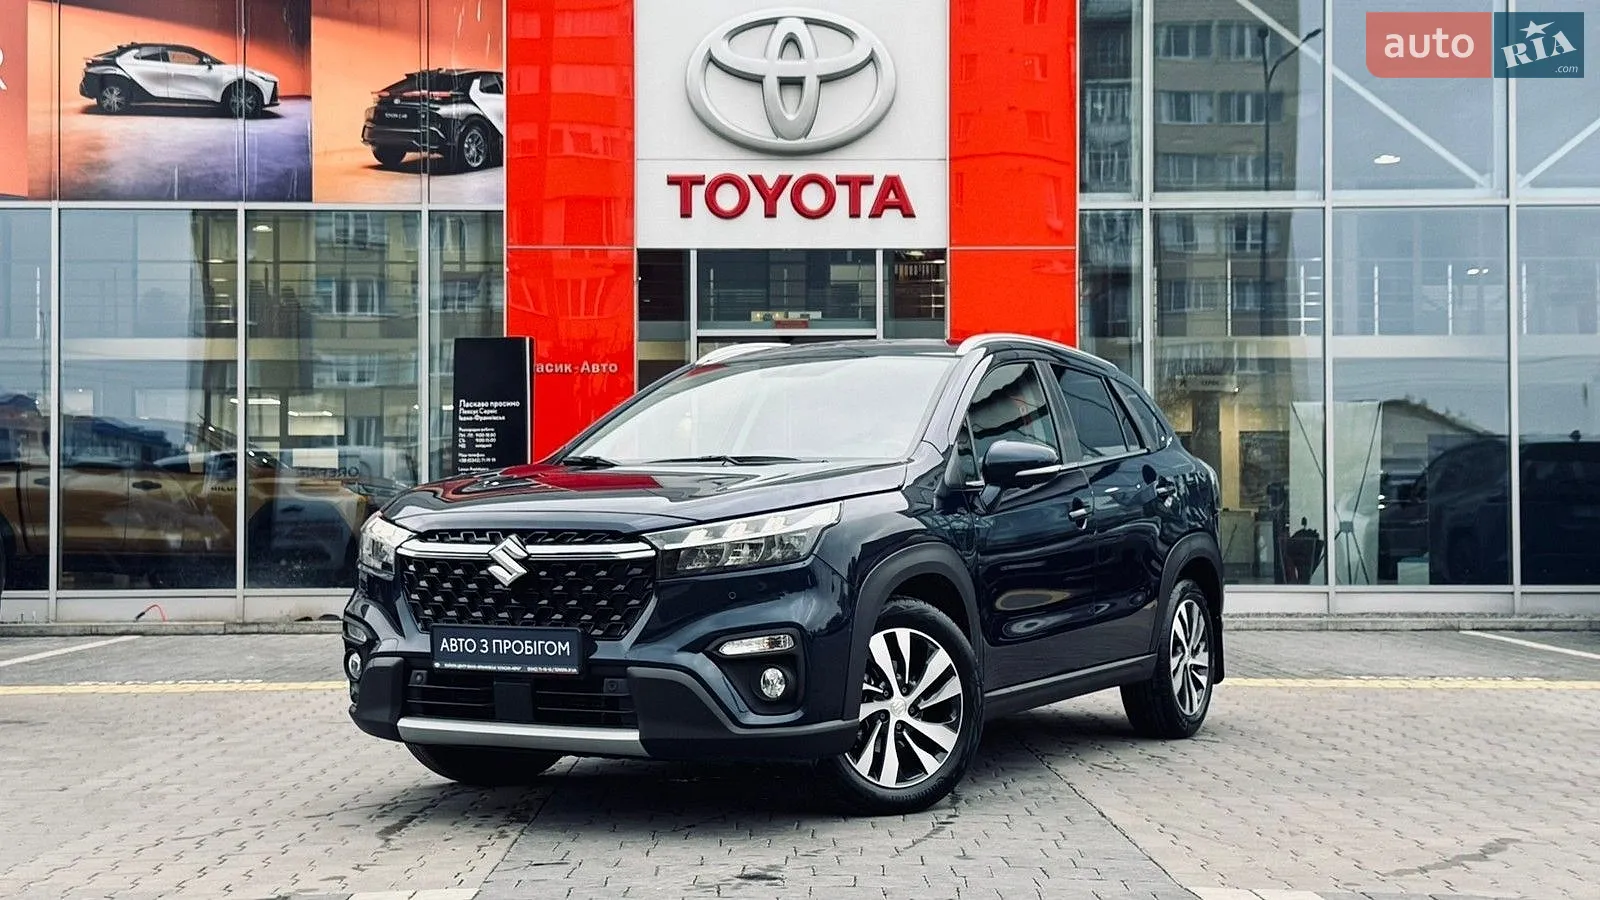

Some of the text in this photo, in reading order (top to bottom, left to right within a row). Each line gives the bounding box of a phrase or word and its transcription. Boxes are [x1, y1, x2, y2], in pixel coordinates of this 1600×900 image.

[666, 173, 916, 219] TOYOTA
[440, 638, 477, 653] АВТО
[492, 639, 570, 656] ПРОБІГОМ
